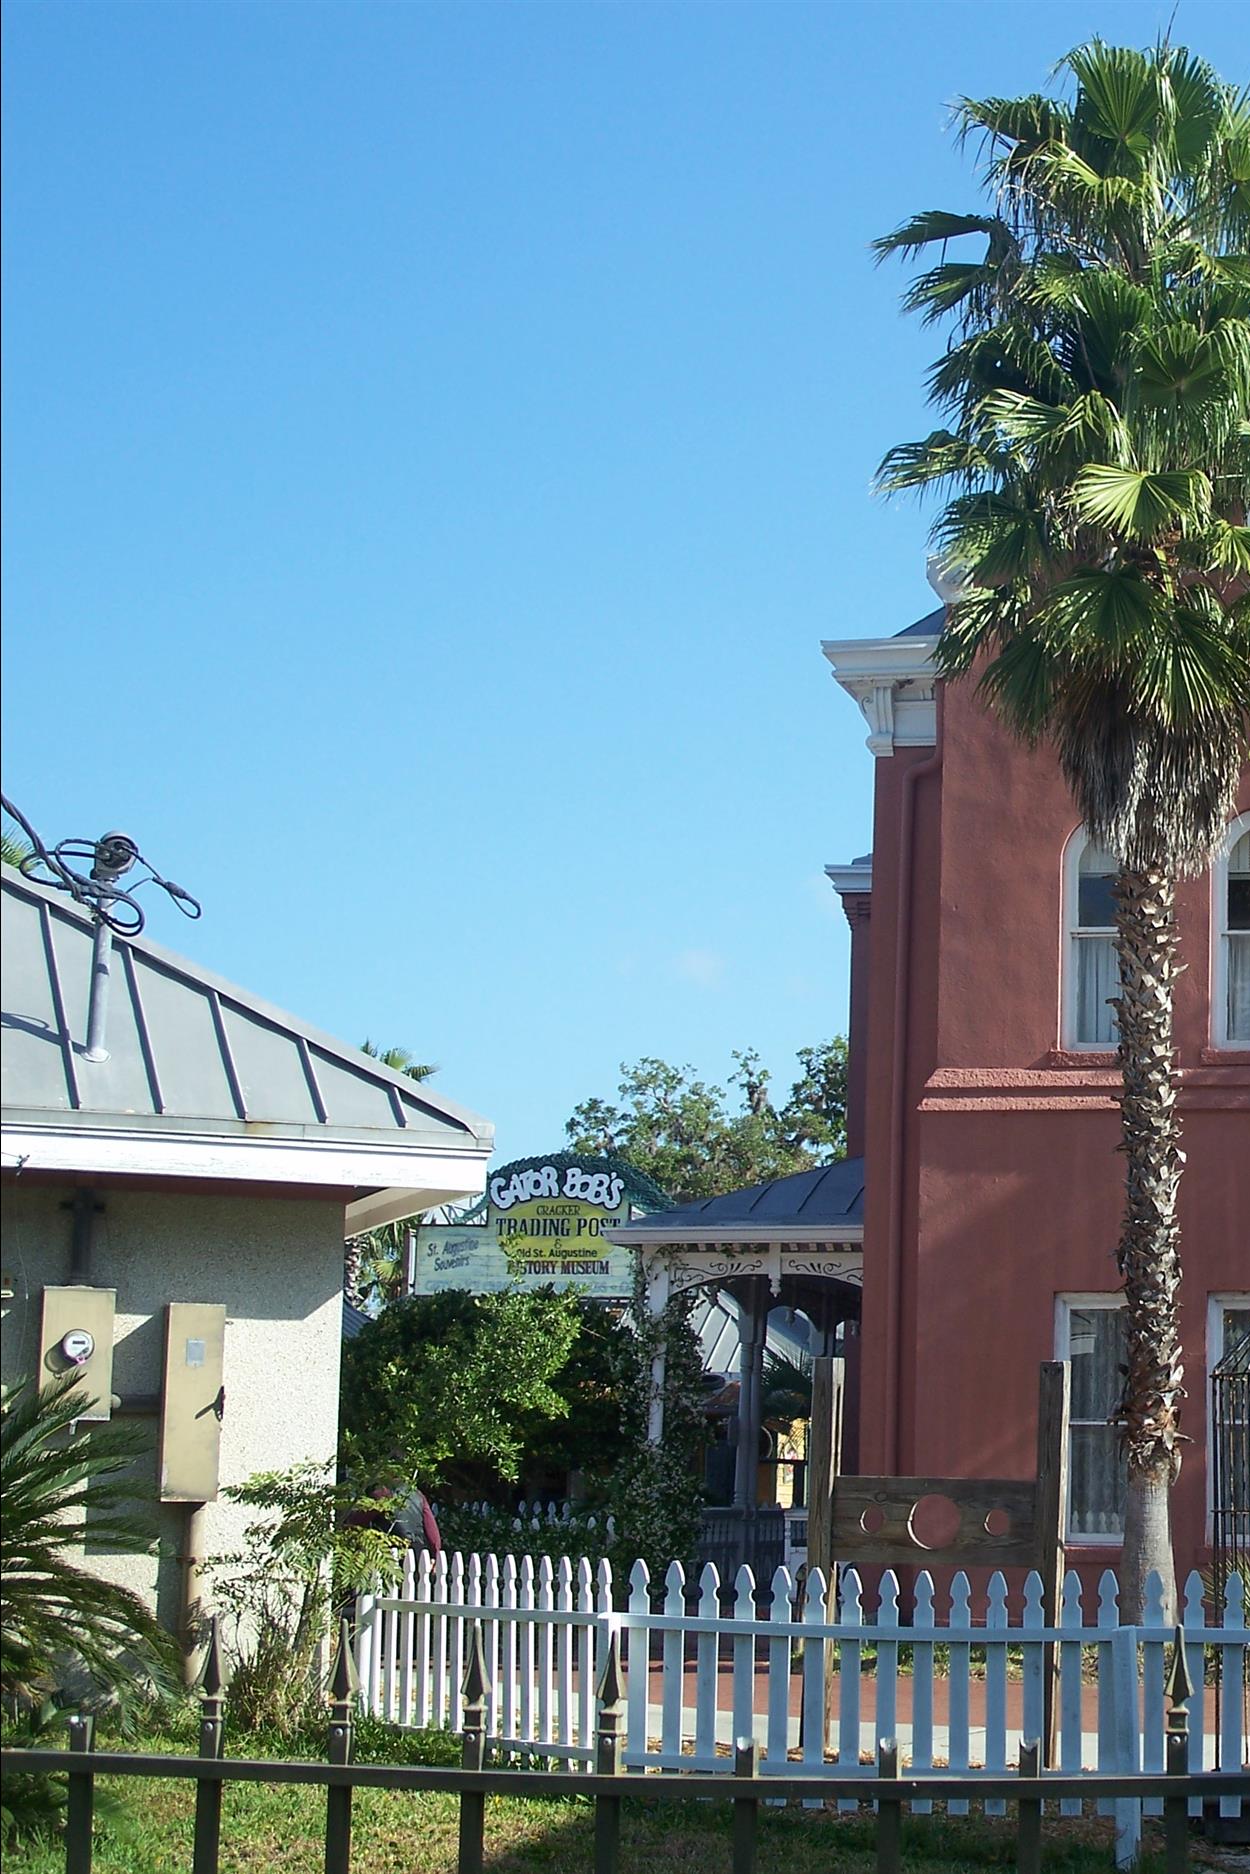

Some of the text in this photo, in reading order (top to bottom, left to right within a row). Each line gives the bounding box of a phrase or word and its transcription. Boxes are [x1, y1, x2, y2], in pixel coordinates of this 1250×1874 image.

[490, 1166, 625, 1209] GATOR BOB'S
[536, 1205, 580, 1216] CRACKER
[496, 1218, 570, 1237] TRADING
[554, 1238, 562, 1249] &
[533, 1249, 546, 1258] St.
[549, 1248, 597, 1260] Augustine
[561, 1260, 610, 1275] MUSEUM
